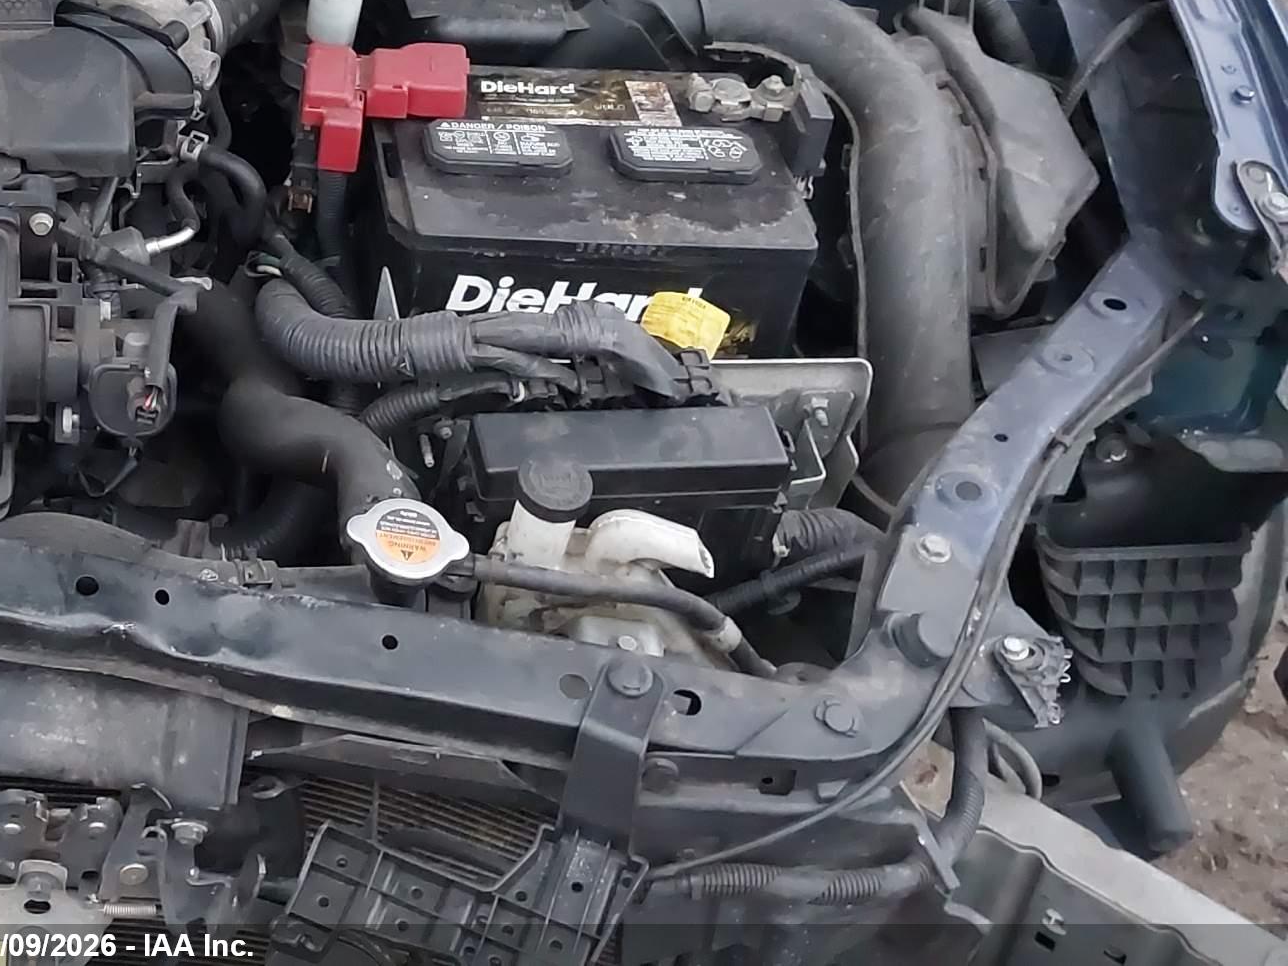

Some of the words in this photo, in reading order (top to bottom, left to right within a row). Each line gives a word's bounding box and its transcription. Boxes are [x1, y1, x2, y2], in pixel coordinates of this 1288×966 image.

[480, 80, 576, 95] DieHard
[451, 122, 495, 130] DANGER
[505, 123, 547, 132] POISON
[445, 274, 703, 323] DieHar
